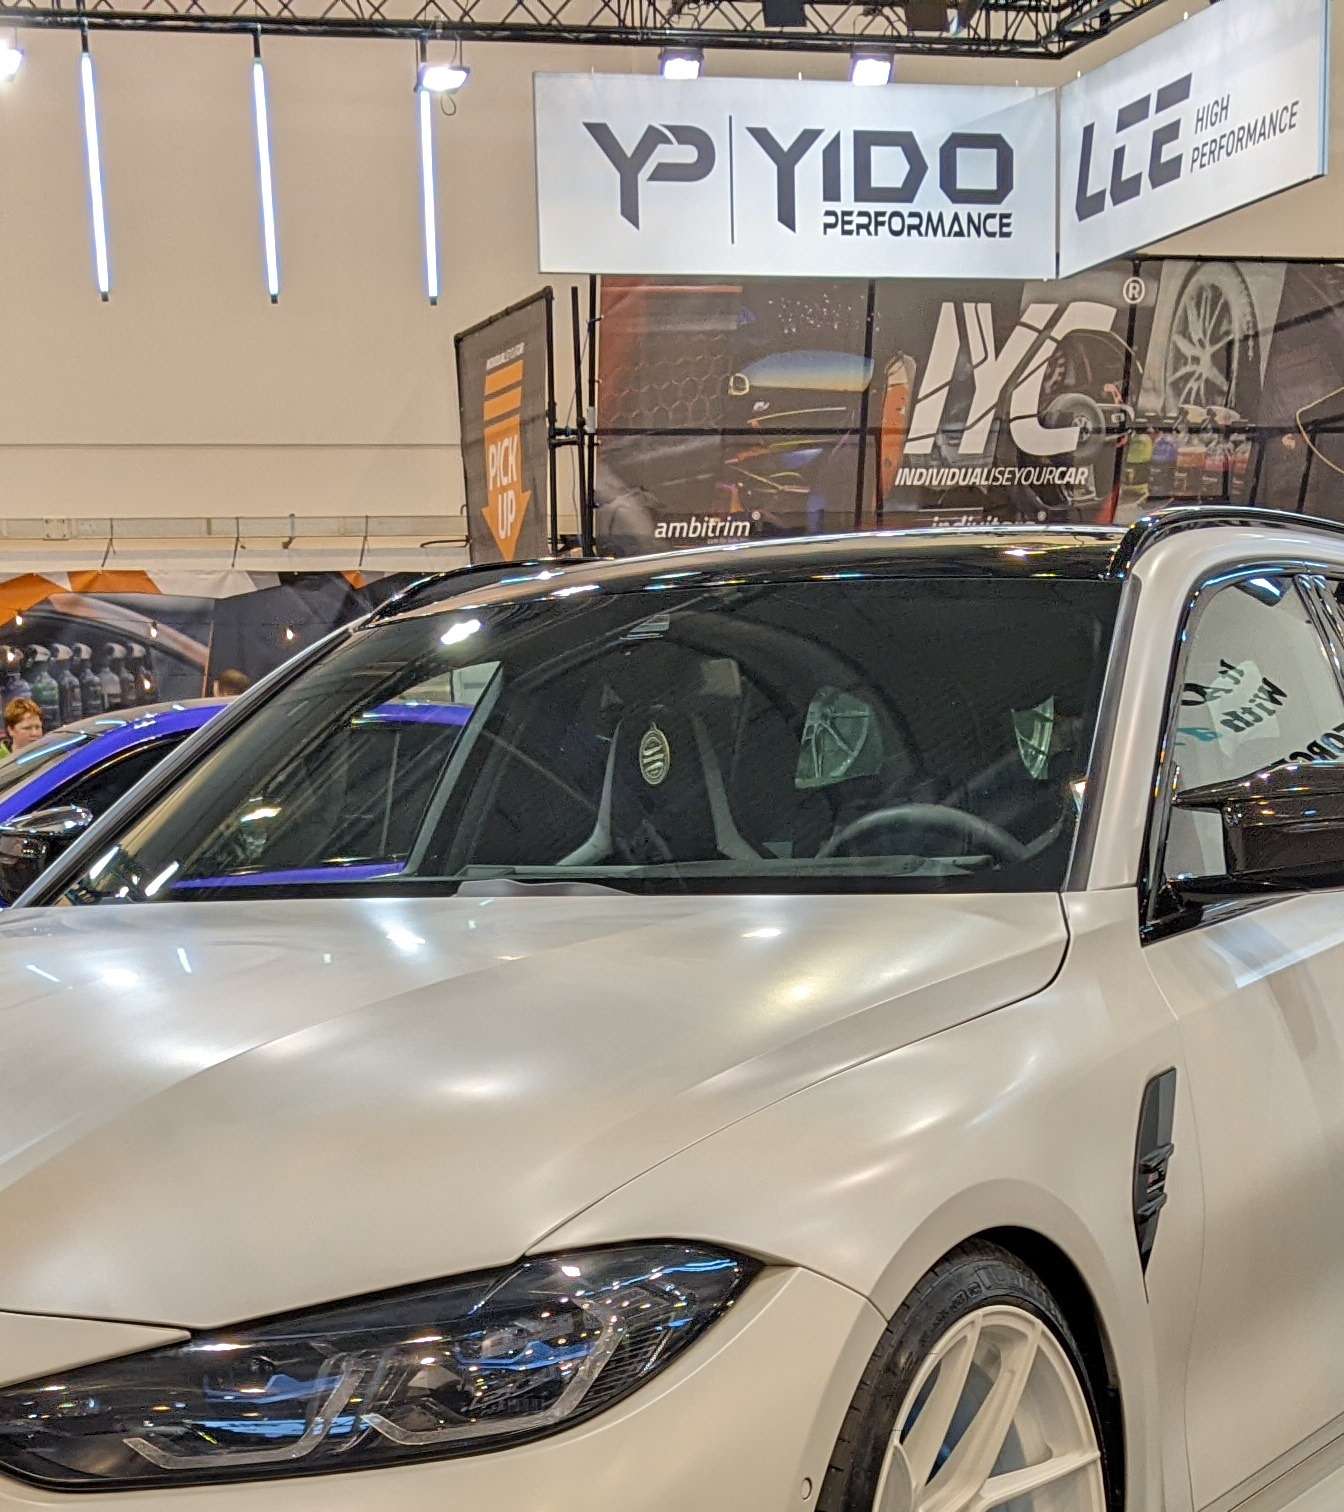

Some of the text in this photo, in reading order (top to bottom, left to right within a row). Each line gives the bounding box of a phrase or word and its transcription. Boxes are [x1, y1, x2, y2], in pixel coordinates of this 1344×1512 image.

[1190, 100, 1300, 174] PERFORMANCE
[1195, 94, 1231, 135] HIGH
[745, 126, 1014, 234] YIDO
[822, 209, 1013, 239] PERFORMANCE
[487, 434, 518, 490] PICK
[498, 488, 516, 539] UP
[655, 515, 751, 539] ambitrim
